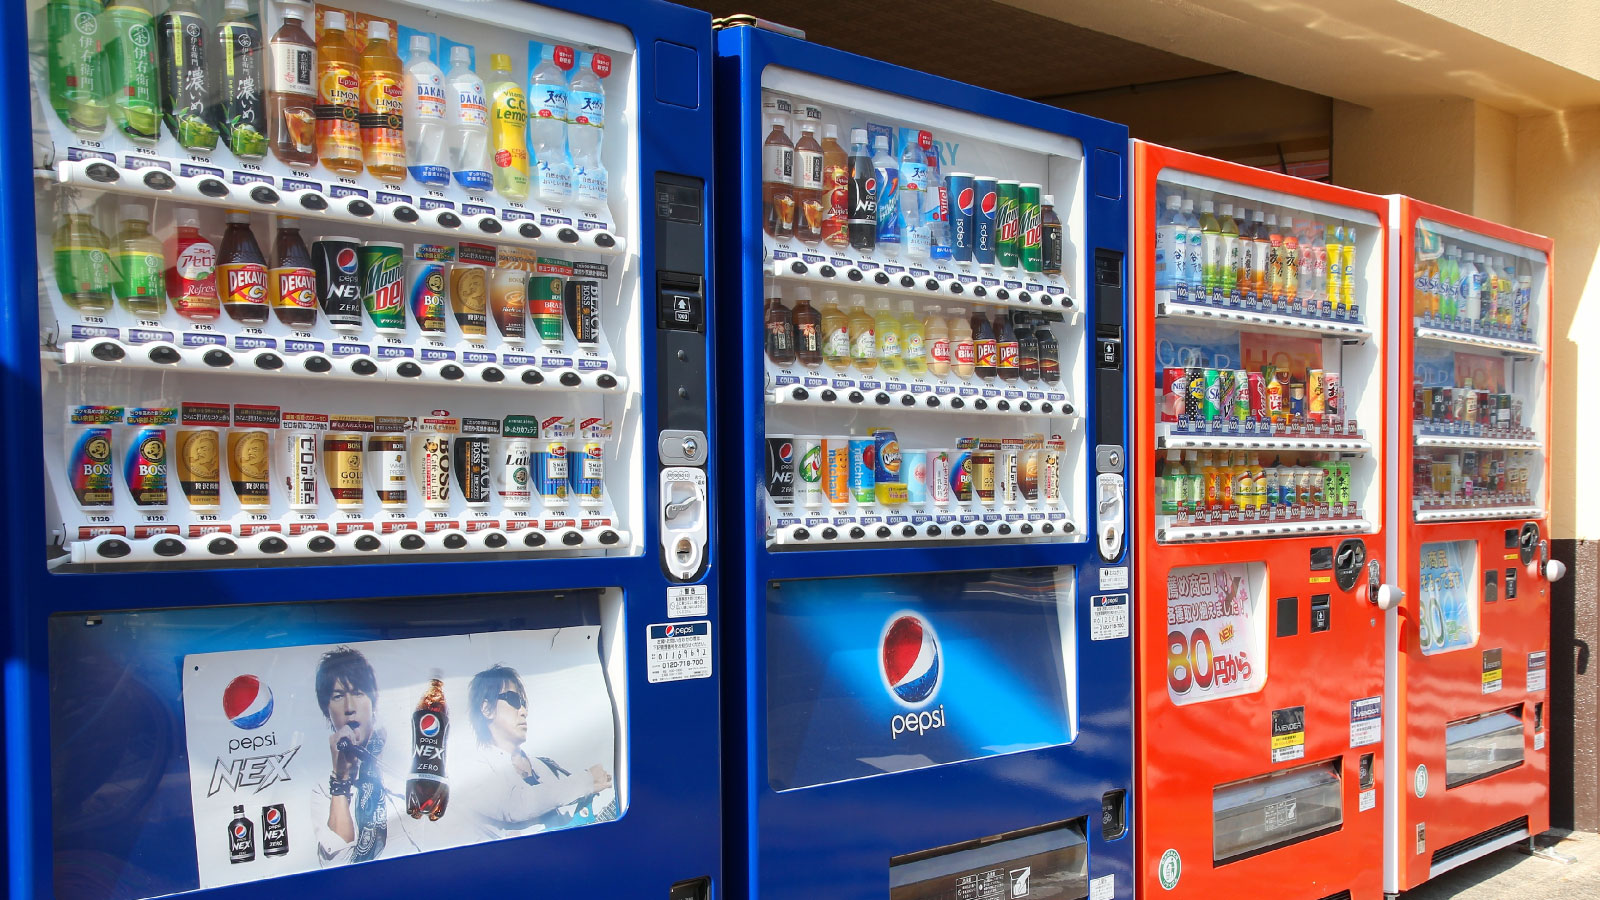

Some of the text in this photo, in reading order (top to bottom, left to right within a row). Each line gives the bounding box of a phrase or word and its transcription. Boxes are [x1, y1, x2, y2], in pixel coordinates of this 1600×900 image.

[80, 139, 101, 148] ¥150
[75, 150, 101, 160] COLD
[135, 148, 157, 156] ¥150
[132, 159, 159, 168] COLD
[191, 156, 210, 164] ¥150
[187, 167, 213, 176] COLD
[243, 163, 261, 171] ¥150
[292, 170, 310, 178] ¥150
[239, 175, 264, 184] COLD
[289, 182, 313, 190] COLD
[336, 188, 362, 198] COLD
[382, 194, 404, 203] COLD
[956, 218, 964, 248] pepsi
[248, 285, 264, 298] C
[299, 289, 313, 303] C
[424, 295, 445, 306] BOS
[140, 319, 159, 327] ¥120
[80, 327, 107, 337] COLD
[137, 331, 163, 341] COLD
[191, 335, 216, 345] COLD
[242, 339, 267, 349] COLD
[292, 342, 315, 352] COLD
[339, 345, 361, 355] COLD
[428, 351, 448, 360] COLD
[508, 355, 527, 364] COLD
[83, 463, 112, 475] BOSS
[138, 463, 166, 475] BOSS
[439, 439, 449, 500] BOSS
[200, 526, 220, 534] HOT
[251, 525, 269, 533] HOT
[300, 525, 318, 533] HOT
[346, 524, 364, 532] HOT
[434, 523, 450, 531] HOT
[514, 521, 529, 529] HOT
[89, 528, 112, 537] HOT
[146, 528, 167, 536] HOT
[675, 625, 694, 635] pepsi
[1219, 625, 1235, 641] NEW
[662, 659, 704, 669] 0120-718-700
[891, 705, 945, 739] pepsi
[228, 731, 276, 754] pepsi
[419, 736, 438, 746] pepsi
[412, 745, 446, 760] NEX
[206, 744, 302, 798] NEX
[416, 763, 439, 771] ZERO
[264, 829, 286, 840] NEX
